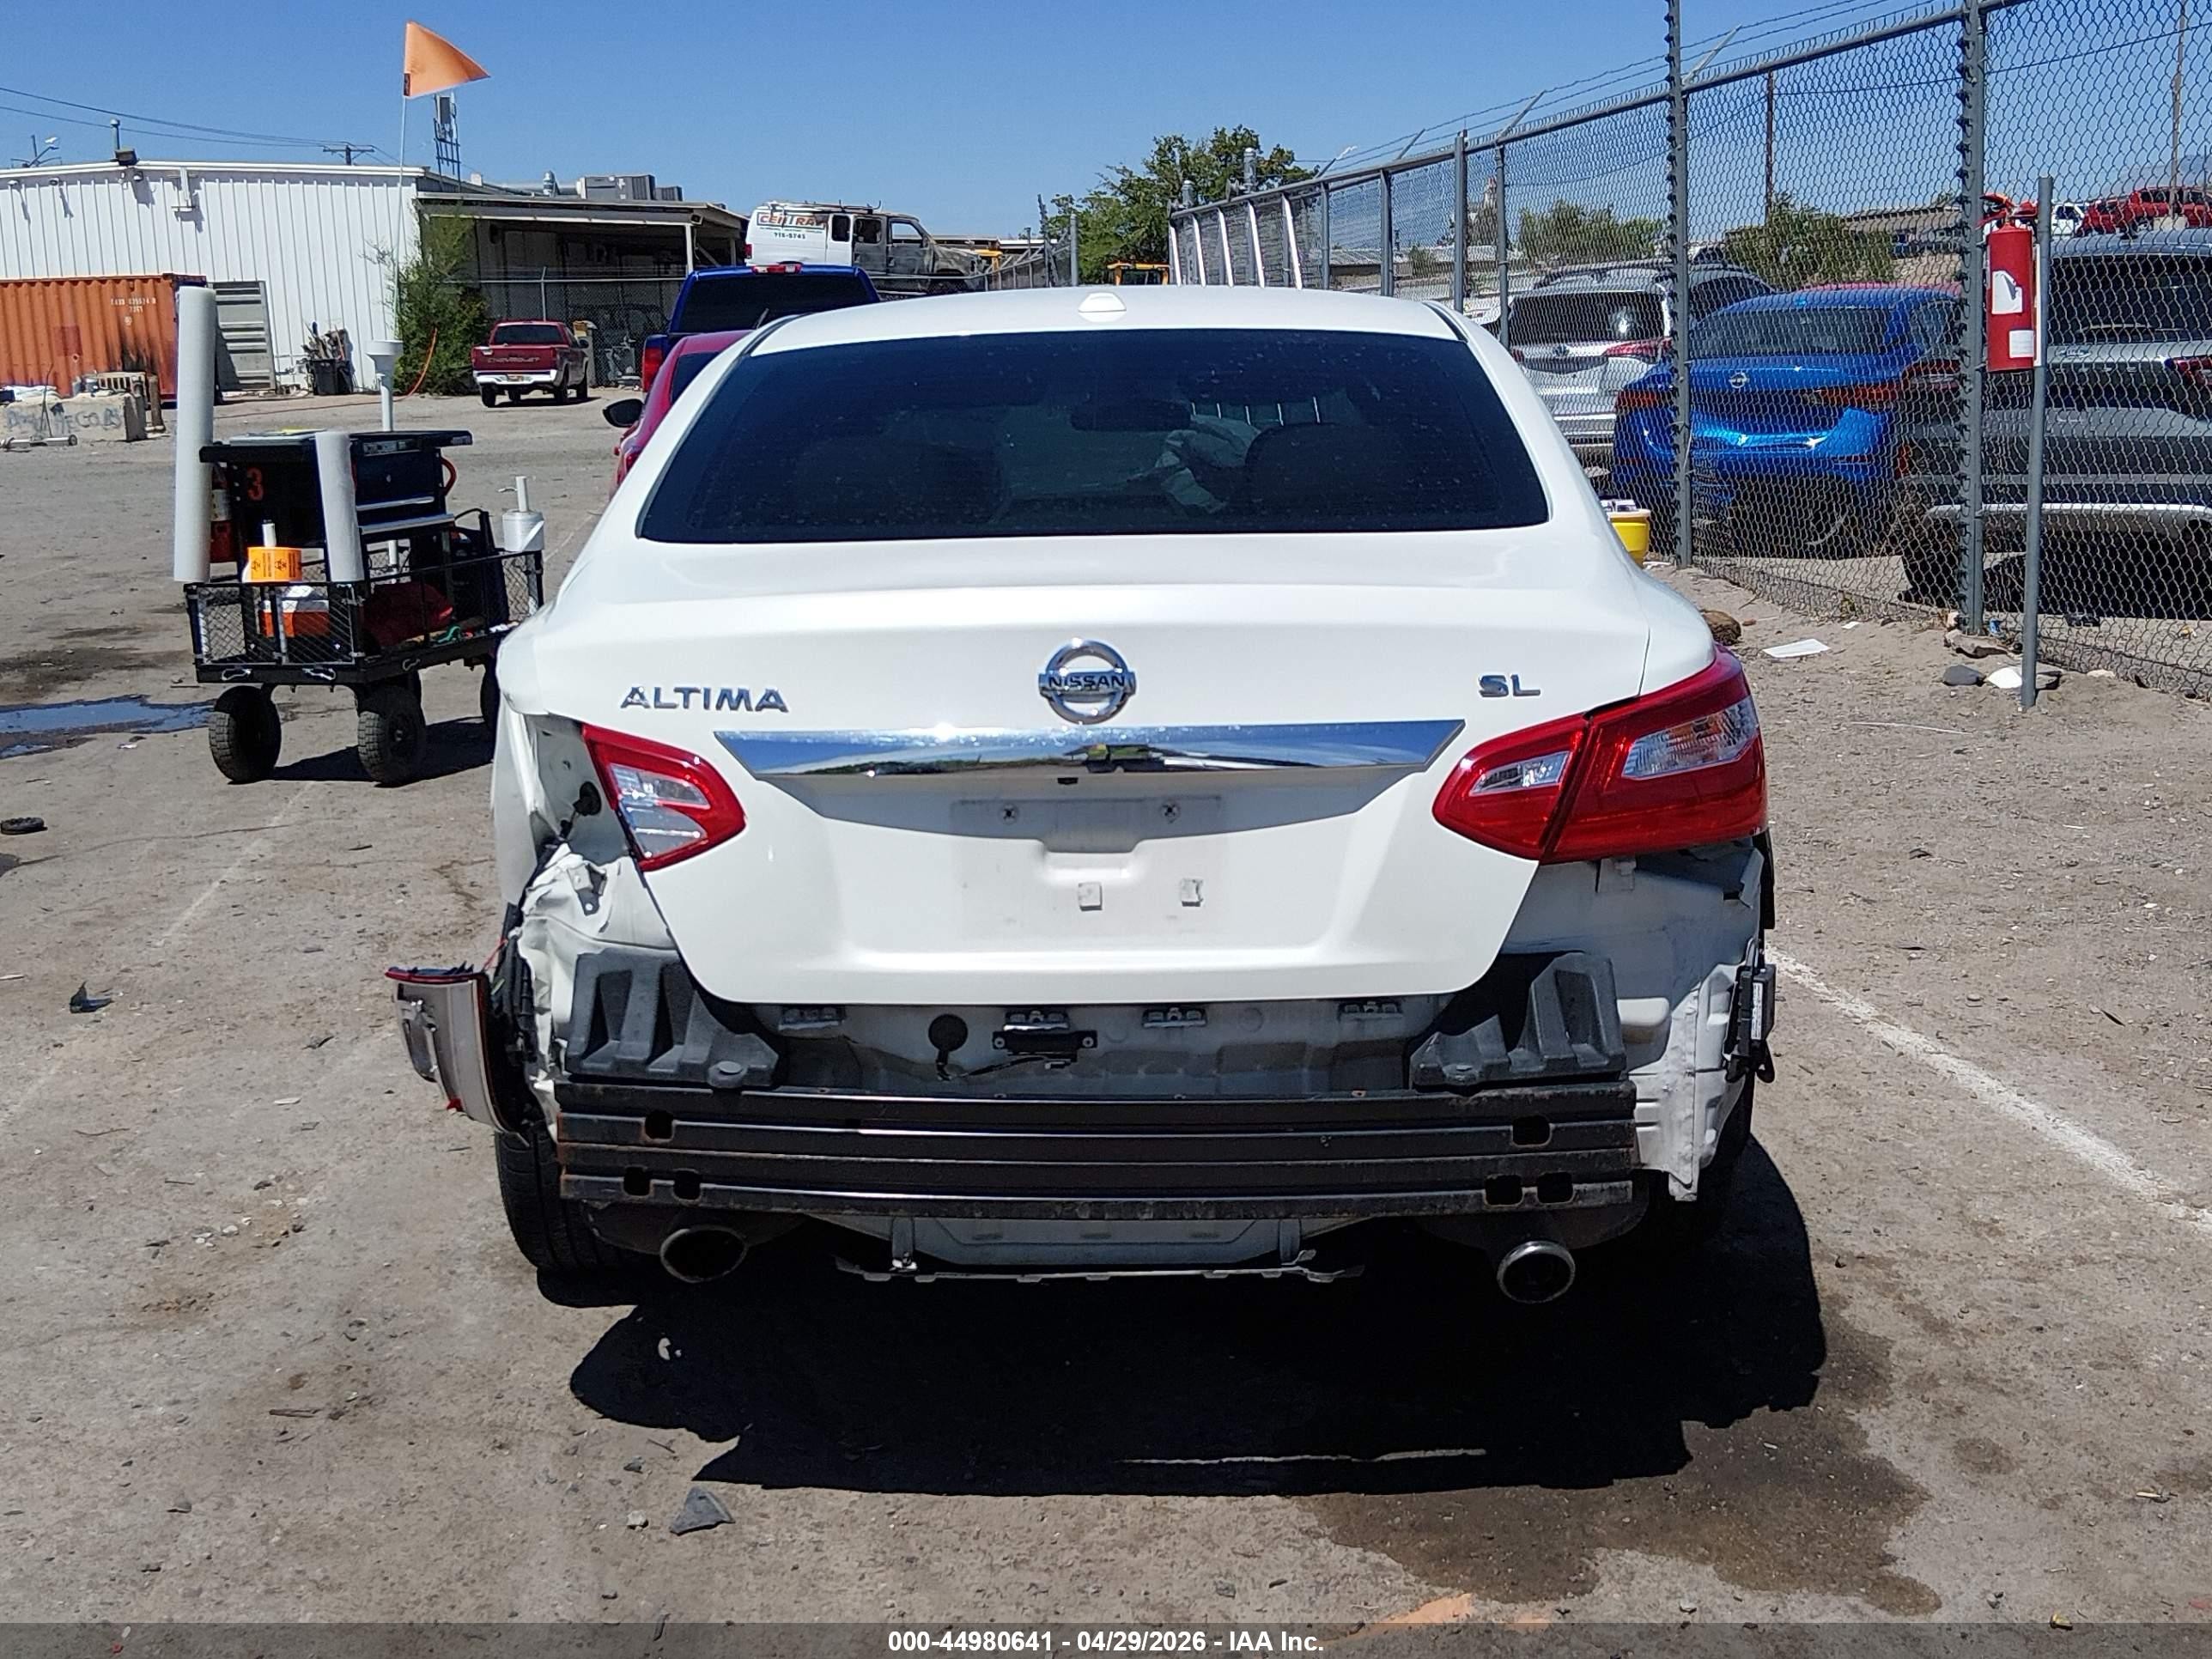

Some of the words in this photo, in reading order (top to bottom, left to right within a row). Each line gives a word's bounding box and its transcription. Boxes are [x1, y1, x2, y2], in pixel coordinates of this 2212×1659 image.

[247, 467, 264, 501] 3
[1048, 675, 1126, 690] NISSAN
[1479, 674, 1541, 697] SL
[621, 686, 789, 713] ALTIMA
